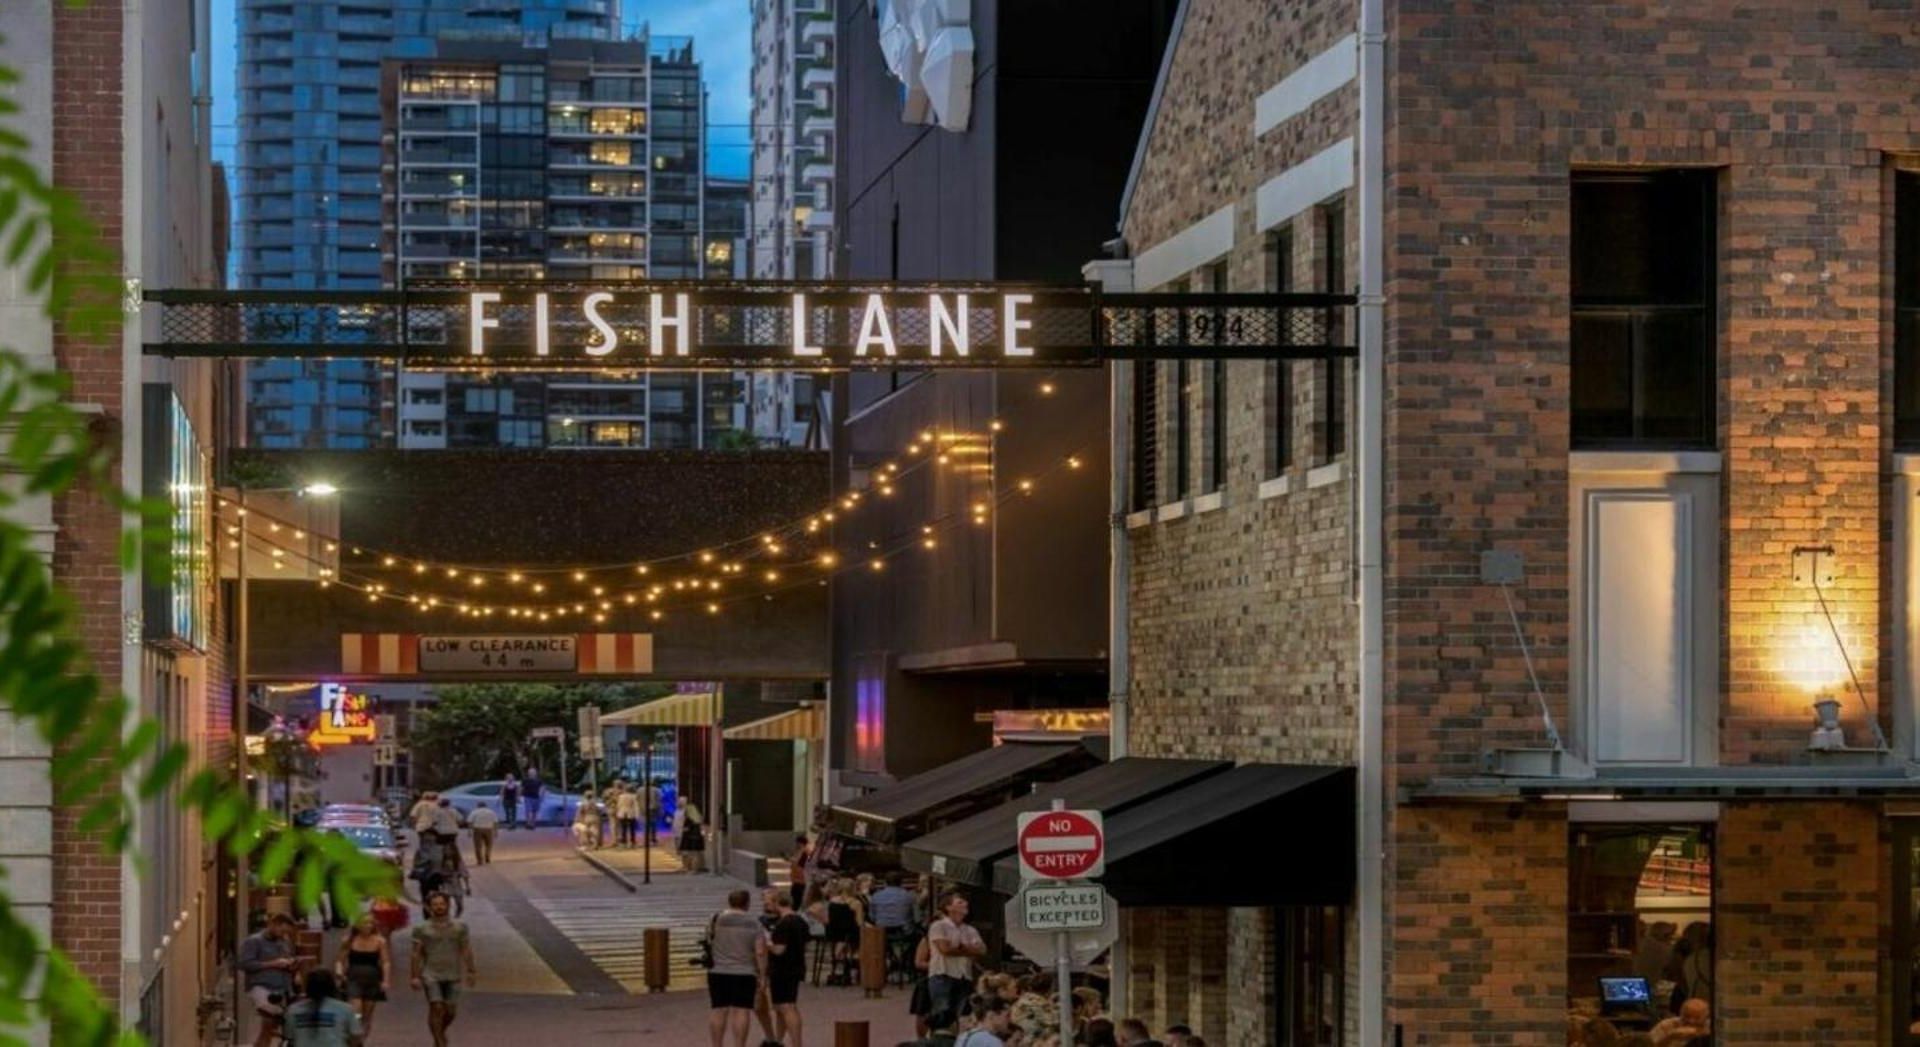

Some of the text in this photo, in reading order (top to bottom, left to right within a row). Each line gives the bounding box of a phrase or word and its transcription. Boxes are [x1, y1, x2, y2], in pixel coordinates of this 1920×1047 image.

[470, 293, 1034, 357] FISH LANE
[426, 639, 570, 652] LOW CLEARANCE
[1049, 820, 1072, 832] NO
[1035, 853, 1088, 868] ENTRY
[1029, 893, 1099, 907] BICYCLES
[1029, 911, 1100, 924] EXCEPTED
